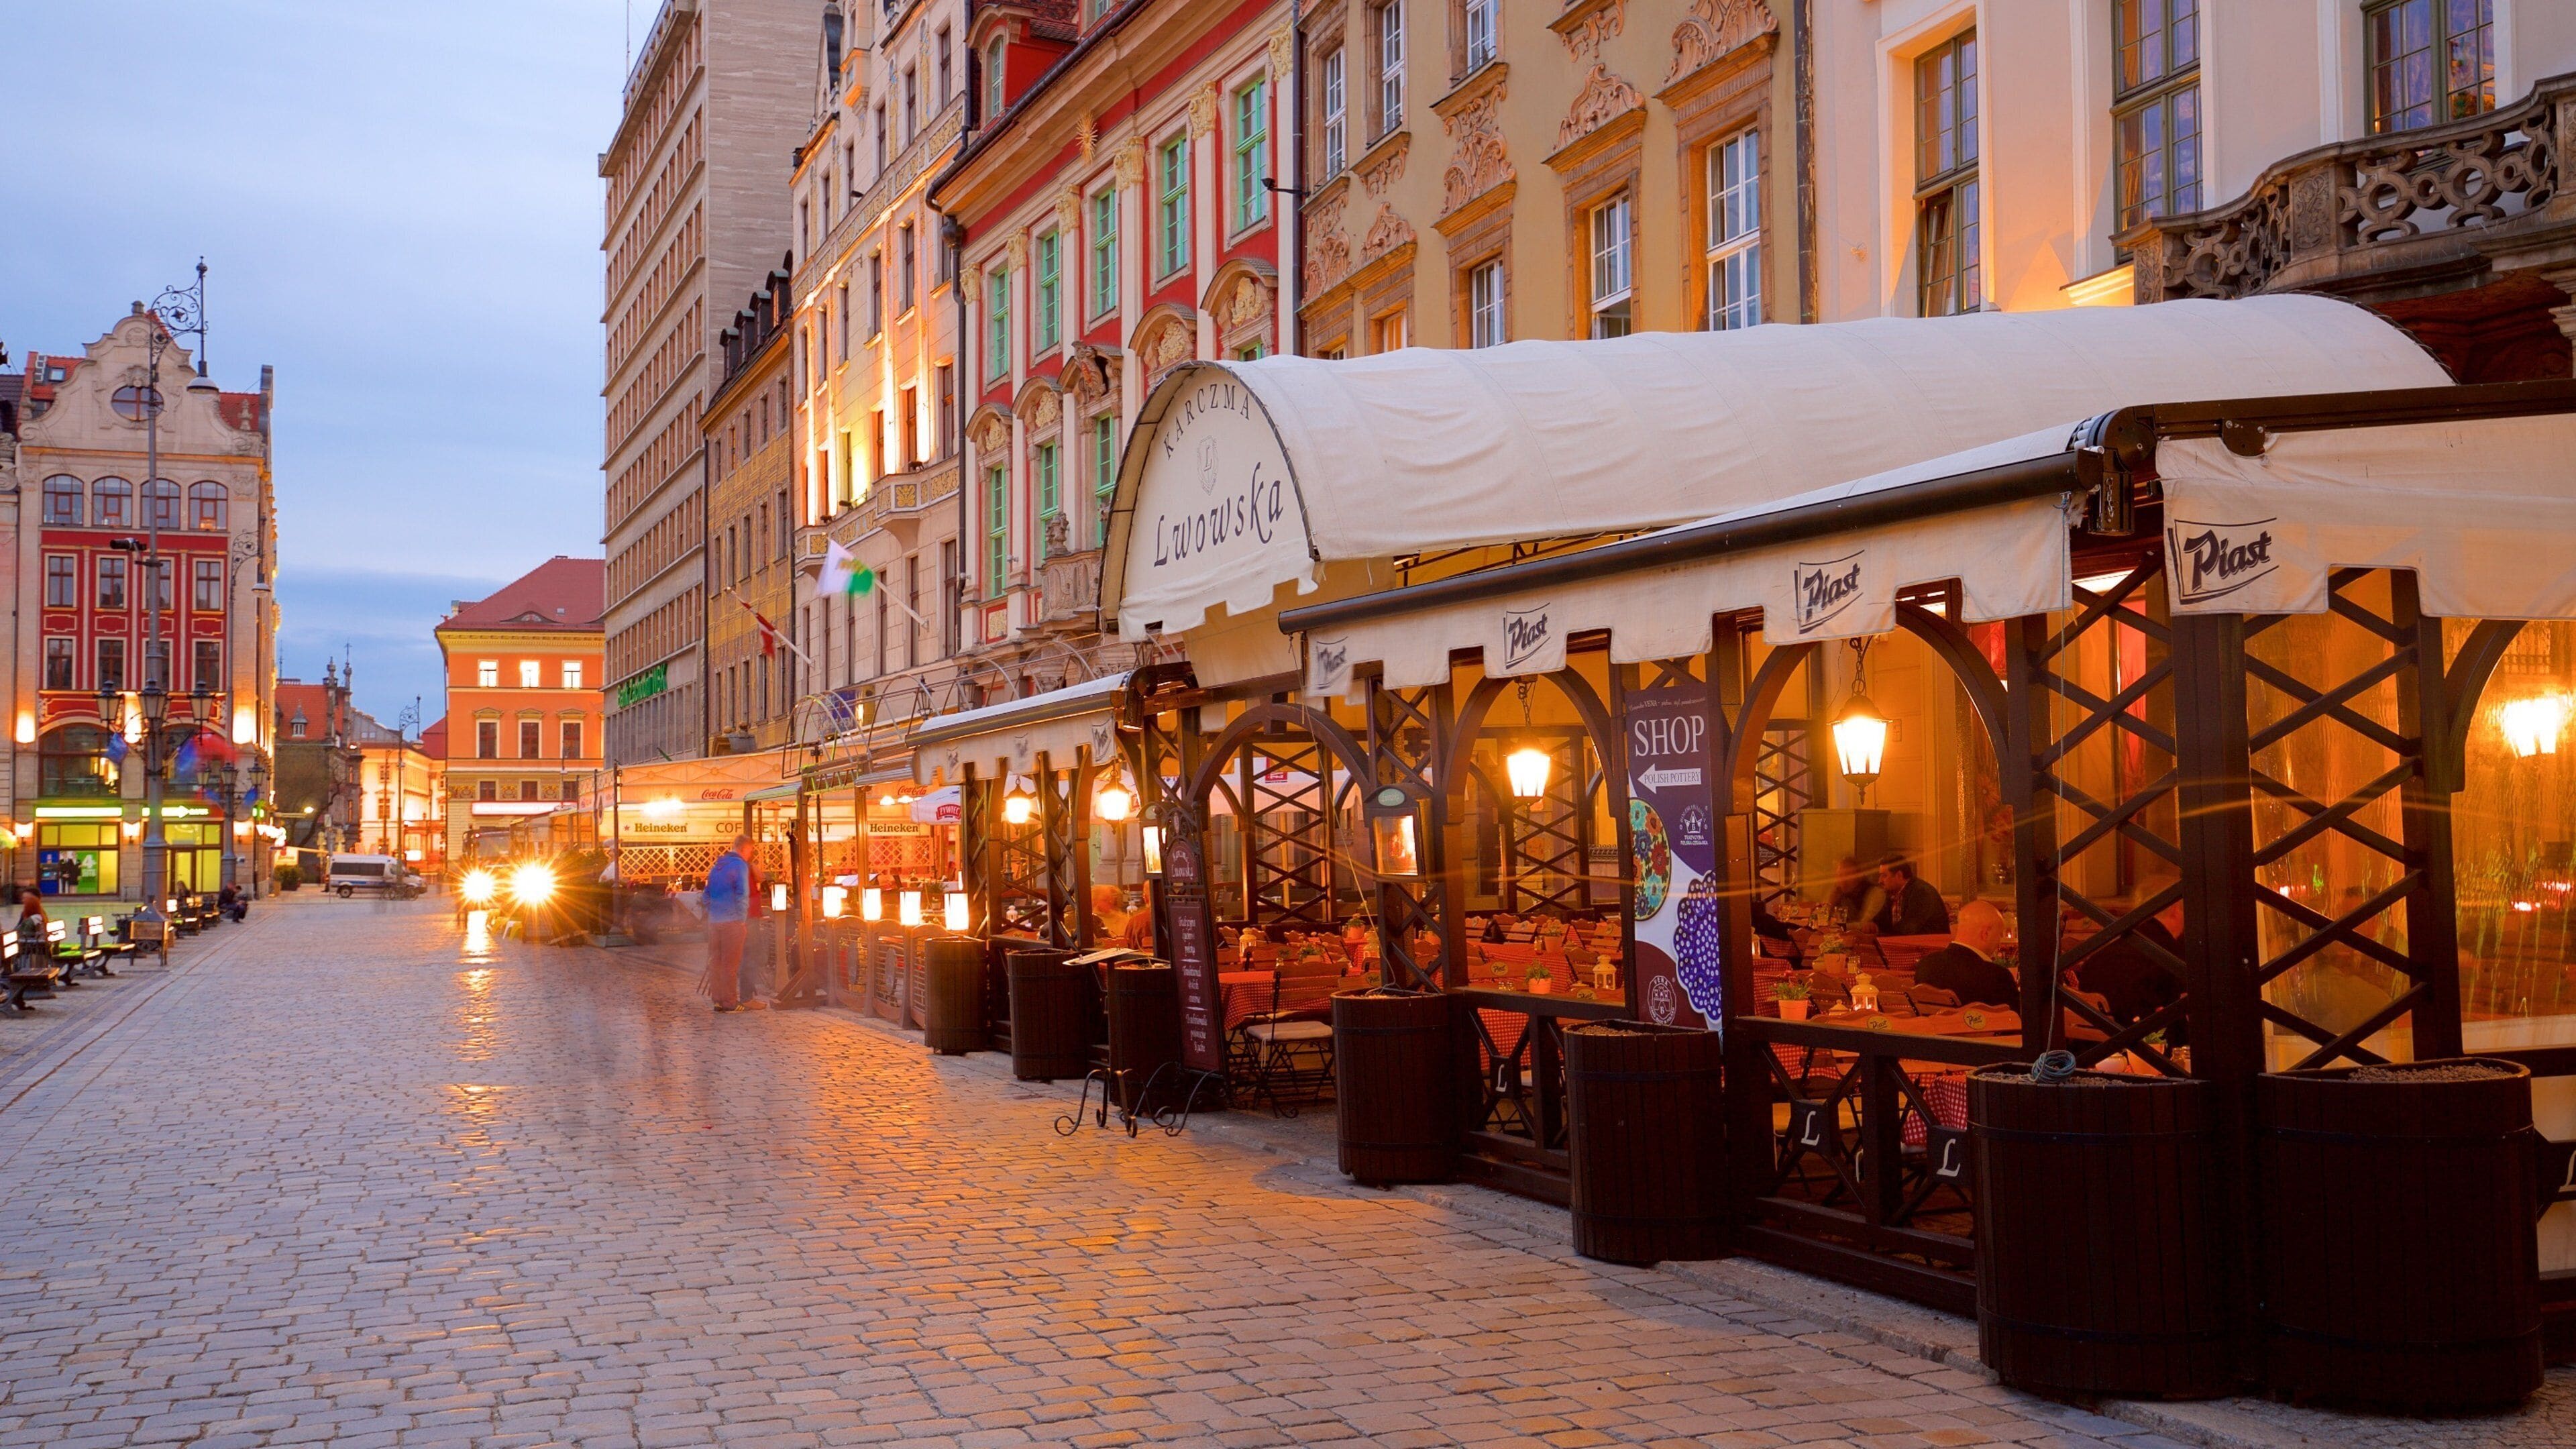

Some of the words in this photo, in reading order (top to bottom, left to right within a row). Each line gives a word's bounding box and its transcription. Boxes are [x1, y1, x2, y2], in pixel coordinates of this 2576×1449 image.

[1164, 384, 1251, 460] KARCZMA
[1154, 462, 1284, 568] Lwowska
[2183, 529, 2272, 592] Piast
[1803, 563, 1860, 623] Piast
[1507, 612, 1548, 660] Piast
[1634, 715, 1705, 757] SHOP
[702, 788, 734, 800] Coca-Cola
[898, 785, 928, 796] Coca-Cola
[1644, 773, 1669, 784] POLISH
[1670, 771, 1700, 783] POTTERY
[635, 823, 686, 833] Heineken
[716, 822, 769, 833] COFEE
[869, 823, 918, 833] Heineken
[1495, 1064, 1507, 1093] L
[1801, 1110, 1820, 1146] L
[1936, 1138, 1961, 1177] L
